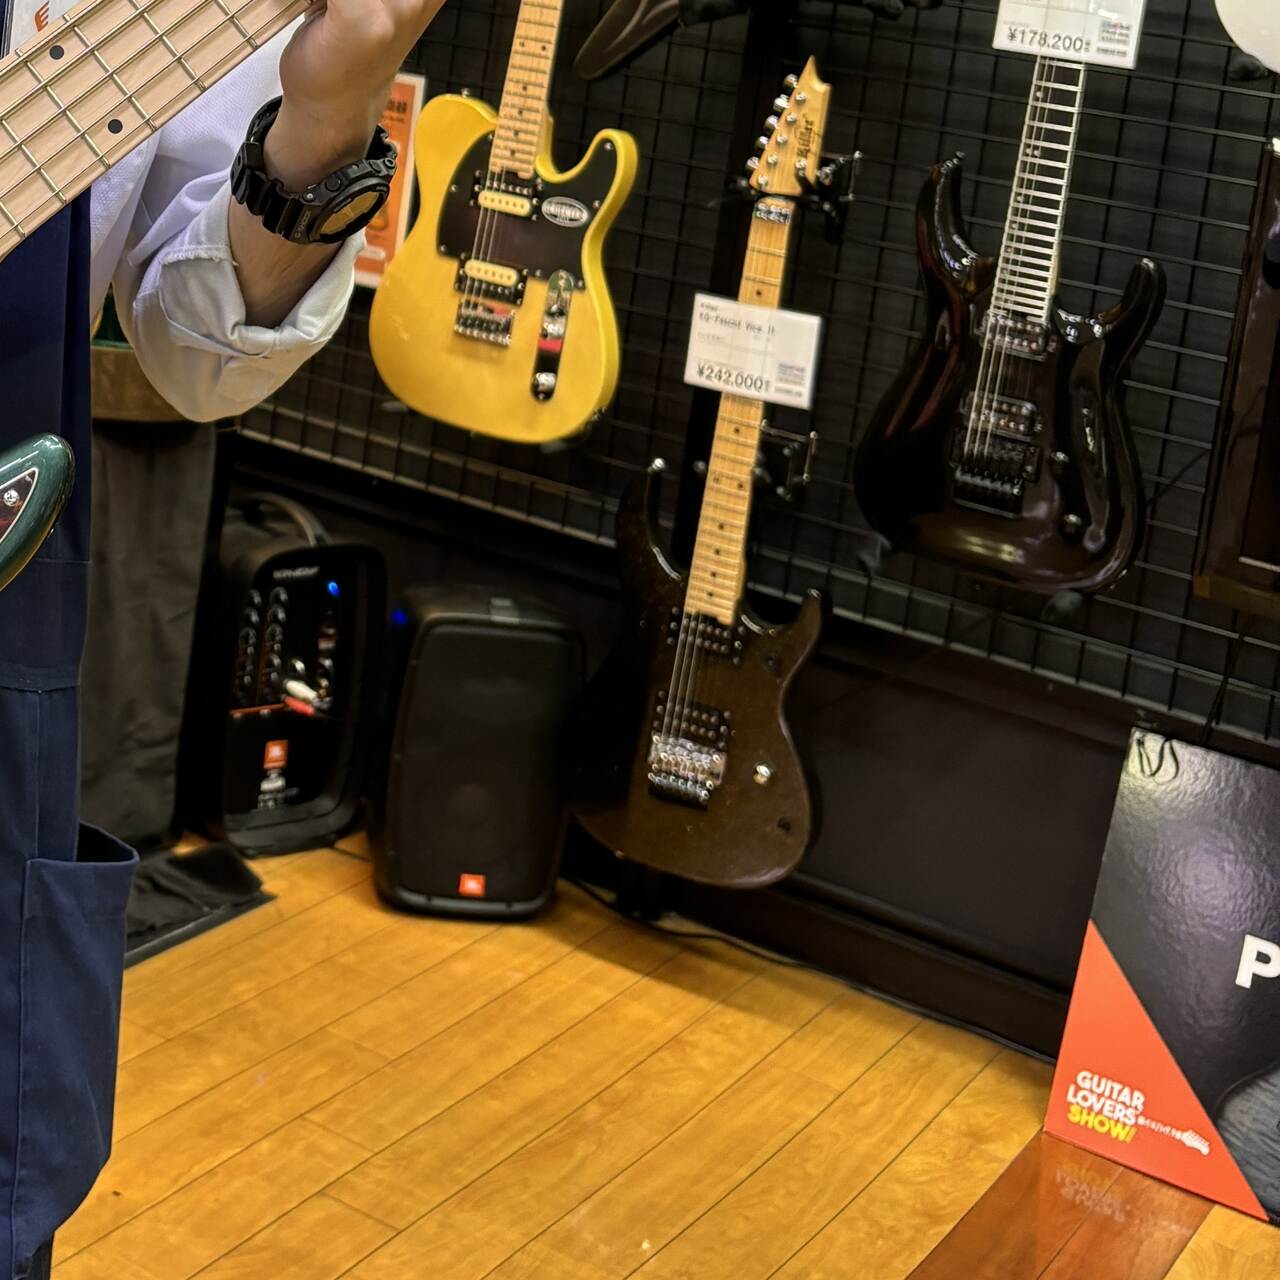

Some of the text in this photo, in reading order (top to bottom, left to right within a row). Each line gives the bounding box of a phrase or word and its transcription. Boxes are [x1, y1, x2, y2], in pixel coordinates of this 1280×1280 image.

[1008, 26, 1084, 53] ¥178,200
[1067, 1084, 1138, 1126] LOVERS
[1076, 1071, 1145, 1108] GUITAR
